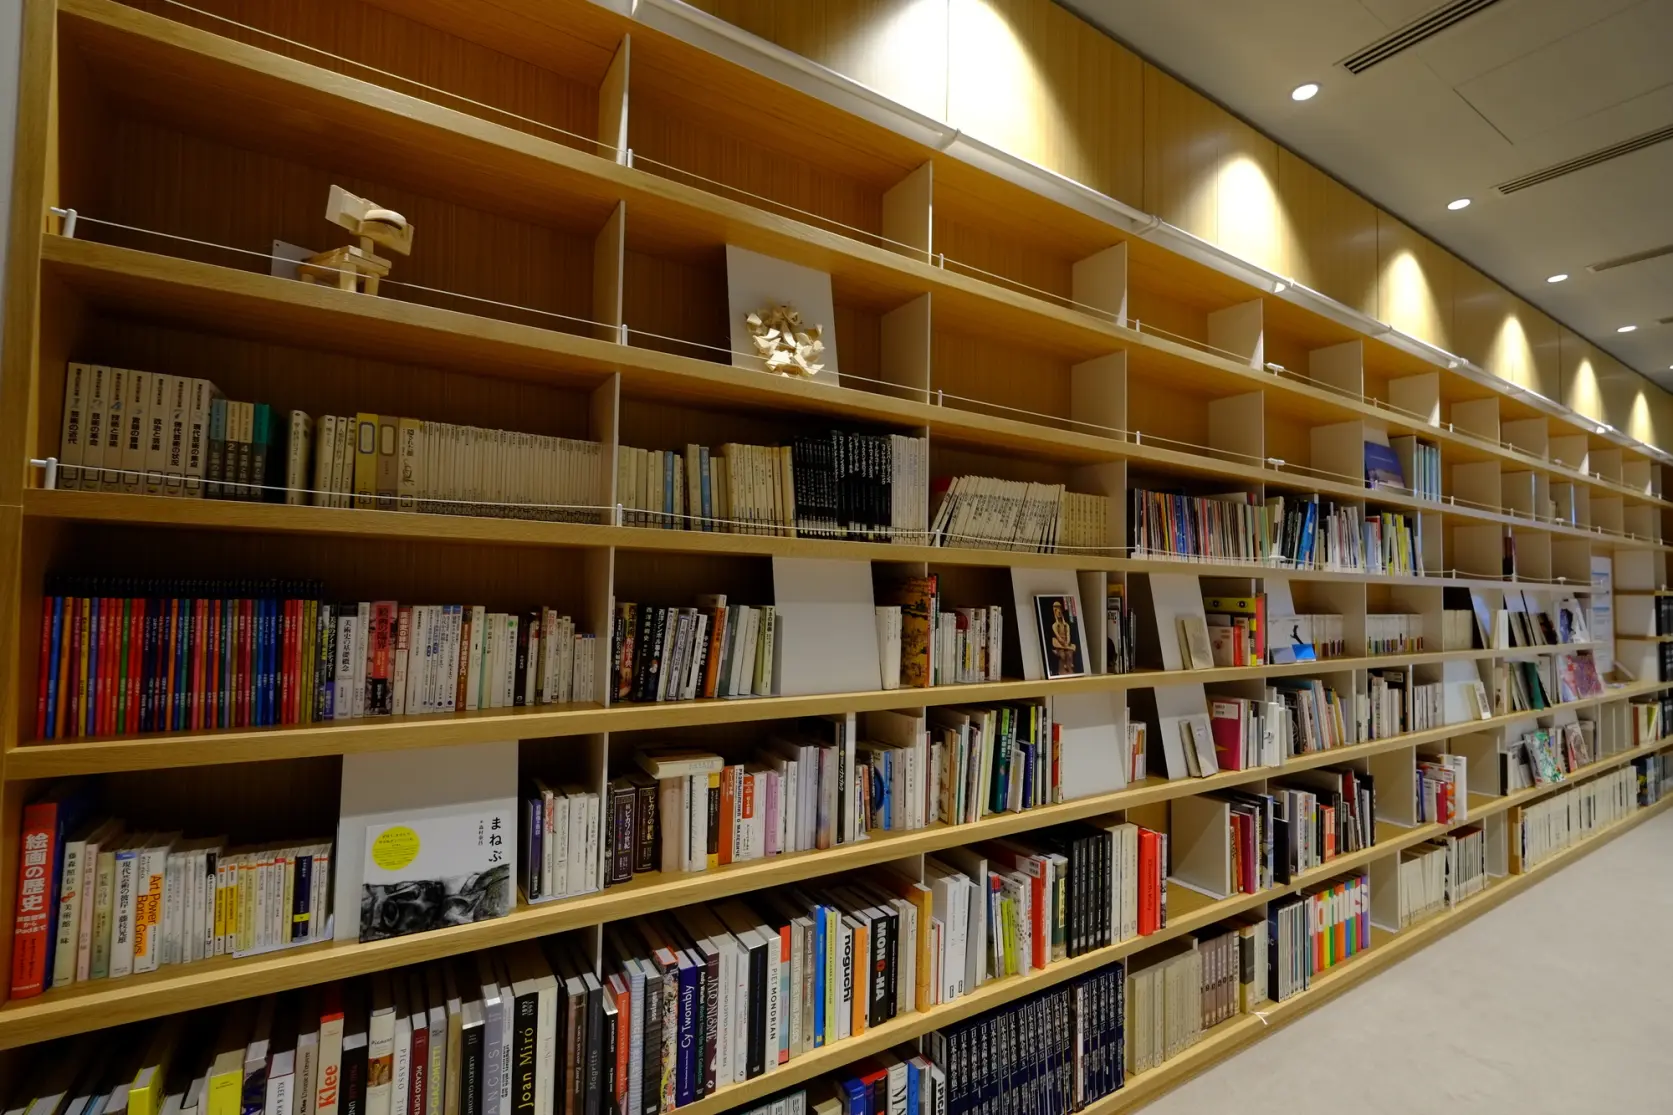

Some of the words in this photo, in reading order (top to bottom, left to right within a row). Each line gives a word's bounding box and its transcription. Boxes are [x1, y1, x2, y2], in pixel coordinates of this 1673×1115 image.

[489, 817, 503, 862] まねぶ
[21, 833, 49, 912] 絵画の歴史
[149, 875, 161, 892] Art
[136, 895, 149, 923] Boris
[147, 893, 160, 924] Power
[135, 924, 147, 955] Groys
[843, 934, 852, 1003] noguchi
[875, 921, 888, 1002] MONO-HA
[682, 985, 695, 1032] Twombly
[769, 987, 777, 1040] MONDRIAN
[519, 1027, 534, 1066] Miró
[681, 1034, 694, 1048] Cy
[318, 1065, 338, 1109] Klee
[397, 1048, 407, 1090] PICASSO
[415, 1065, 423, 1093] PICASSO
[589, 1050, 598, 1090] Magritte
[518, 1072, 535, 1108] Joan
